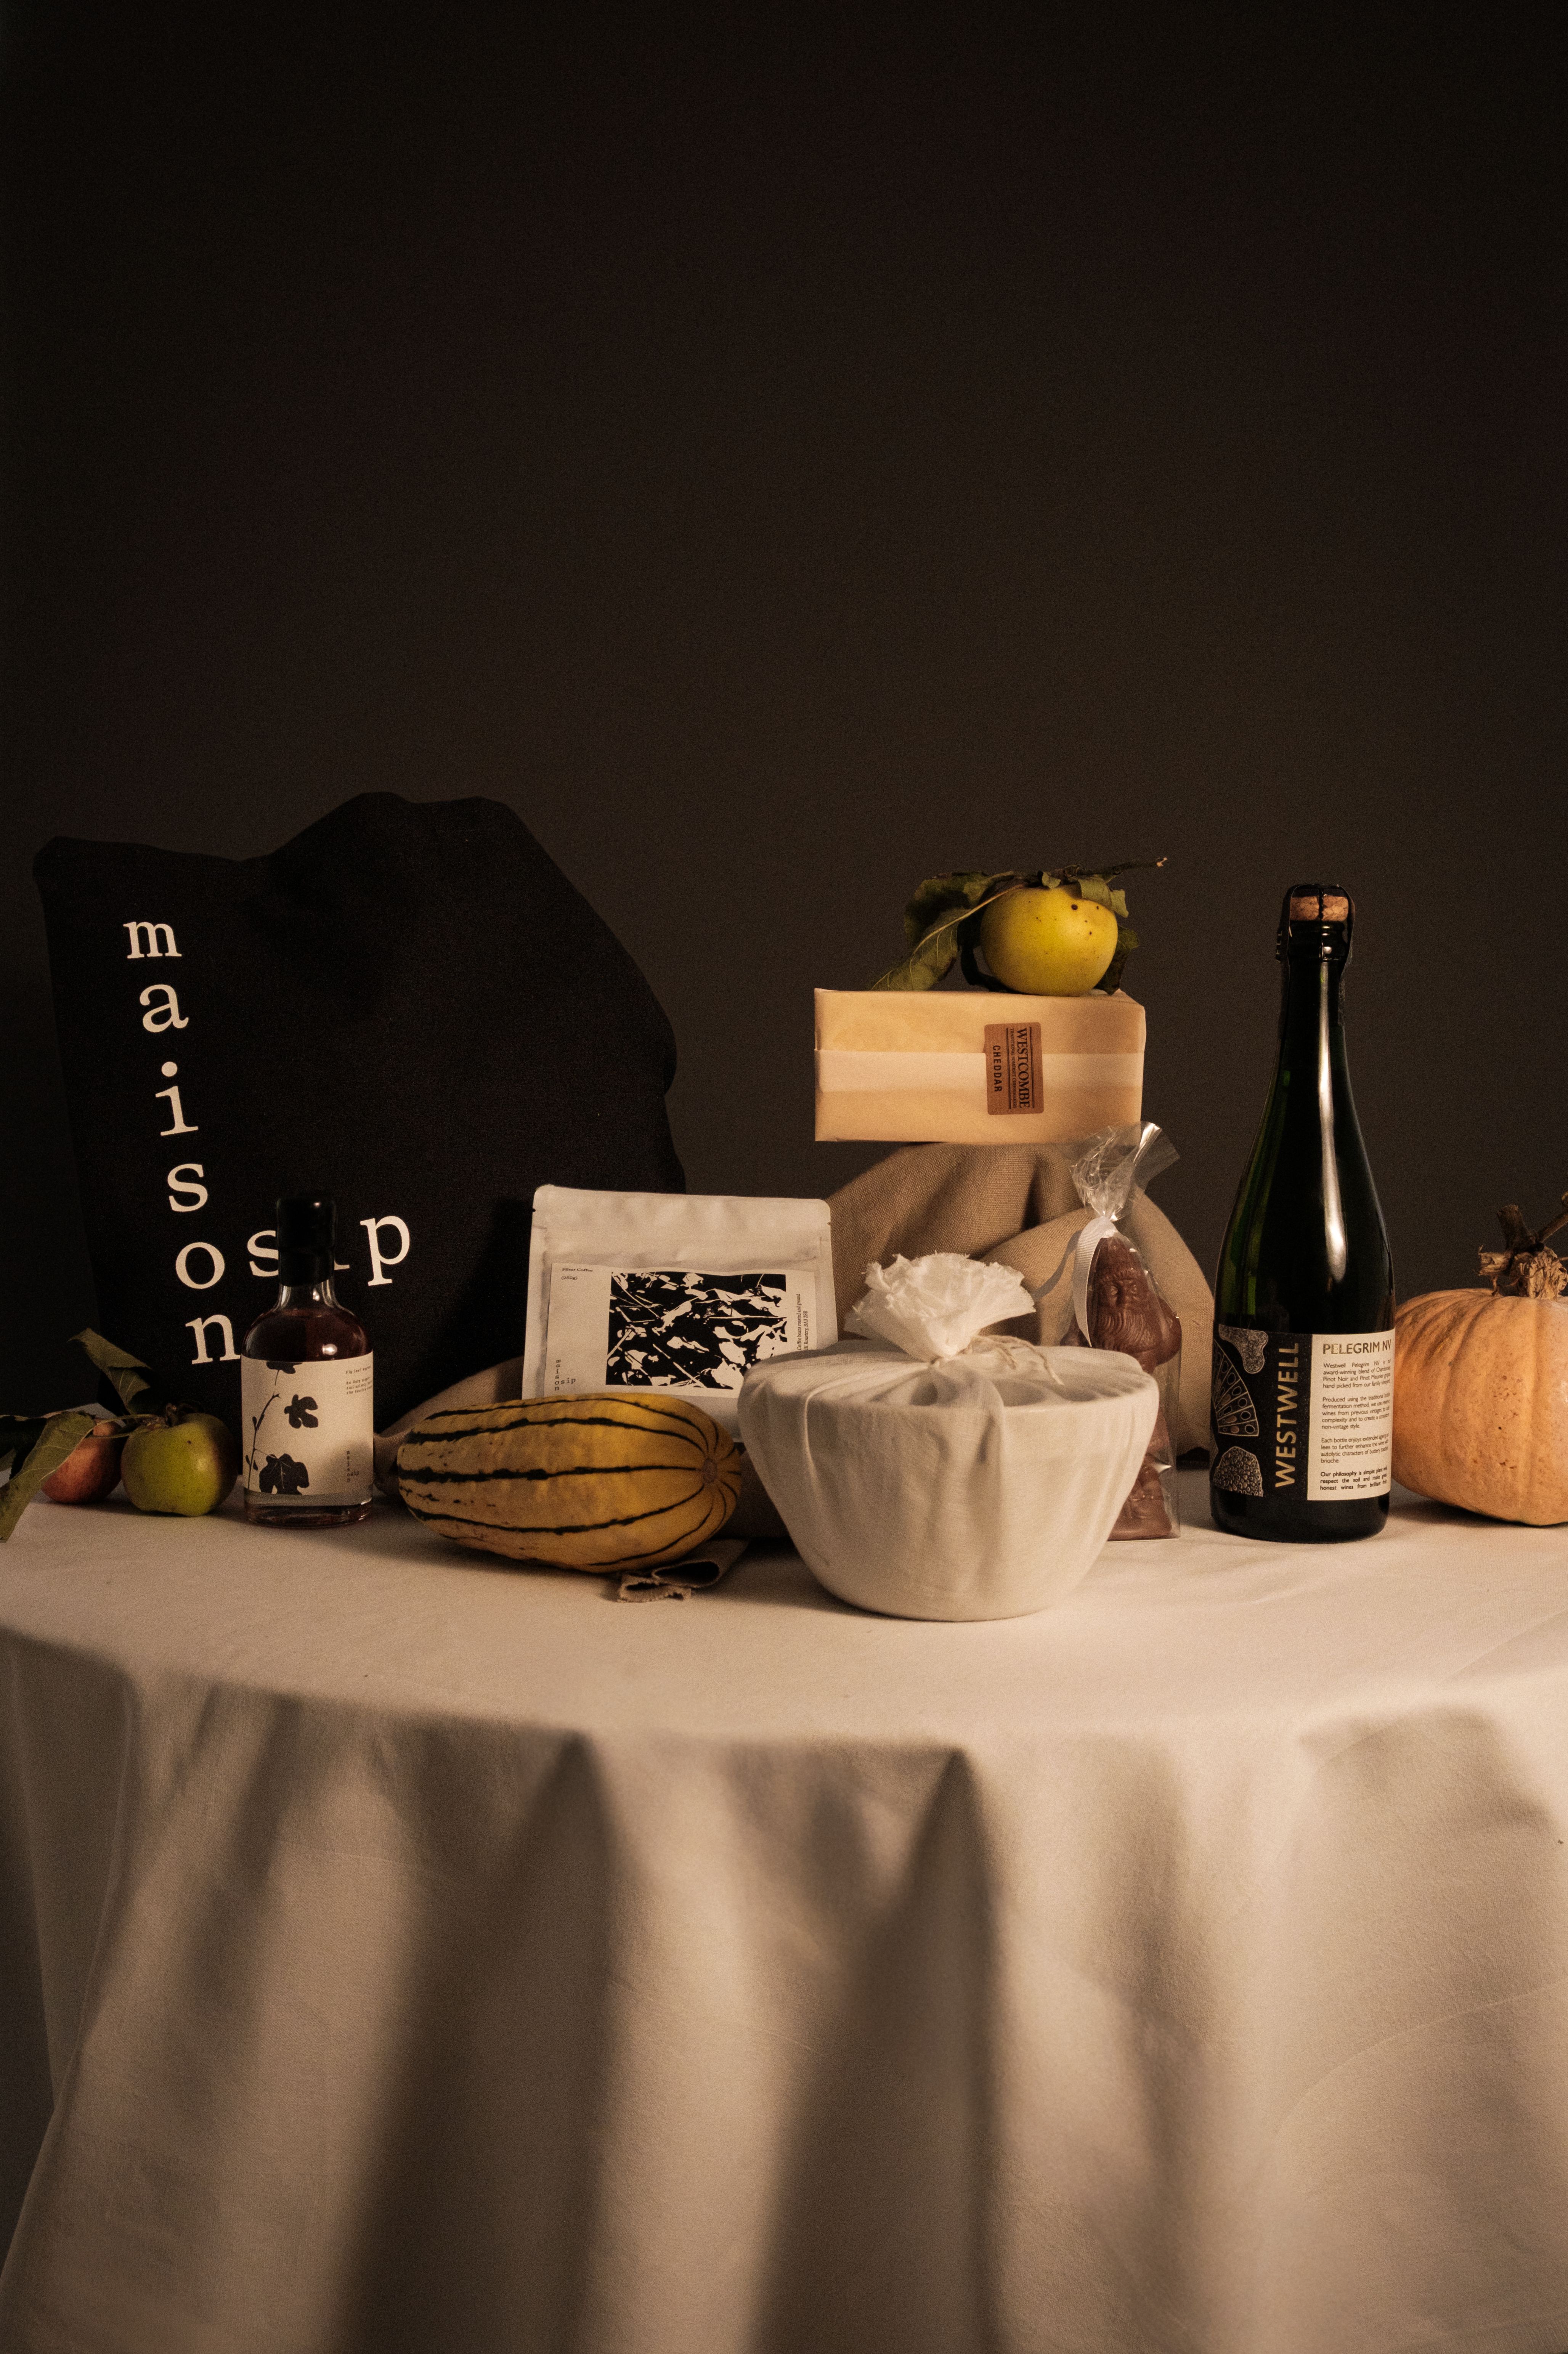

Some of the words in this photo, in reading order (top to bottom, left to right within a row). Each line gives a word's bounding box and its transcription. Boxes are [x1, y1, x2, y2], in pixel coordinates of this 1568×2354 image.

[993, 1045, 1002, 1092] CHEDDAR
[1017, 1028, 1030, 1108] WESTCOMBE
[1323, 1341, 1380, 1354] PELEGRIM
[1382, 1339, 1391, 1351] NV
[1275, 1342, 1299, 1487] WESTWELL
